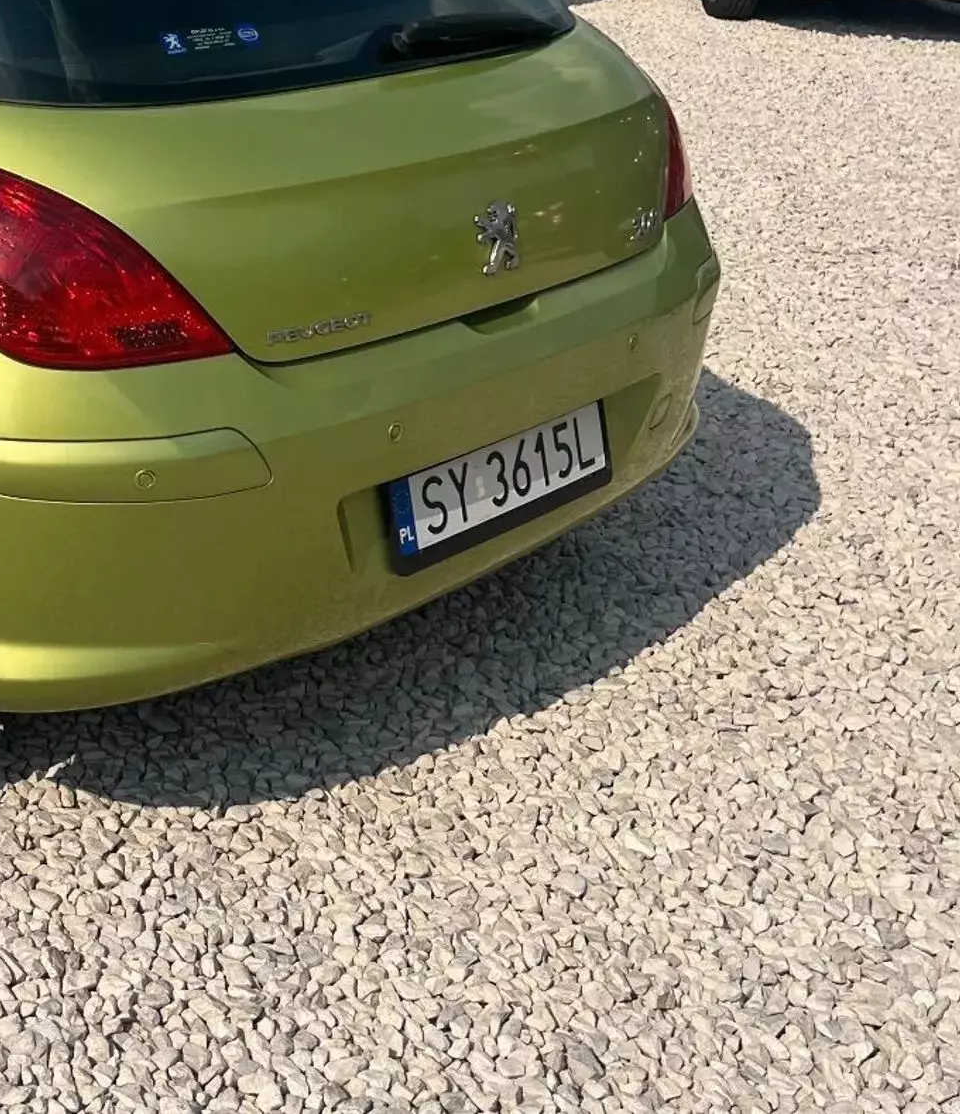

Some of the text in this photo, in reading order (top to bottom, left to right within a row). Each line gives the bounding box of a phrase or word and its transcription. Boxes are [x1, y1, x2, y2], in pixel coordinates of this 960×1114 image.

[266, 312, 372, 345] PEUGEOT
[422, 417, 595, 534] SY 3615L
[399, 526, 415, 545] PL
